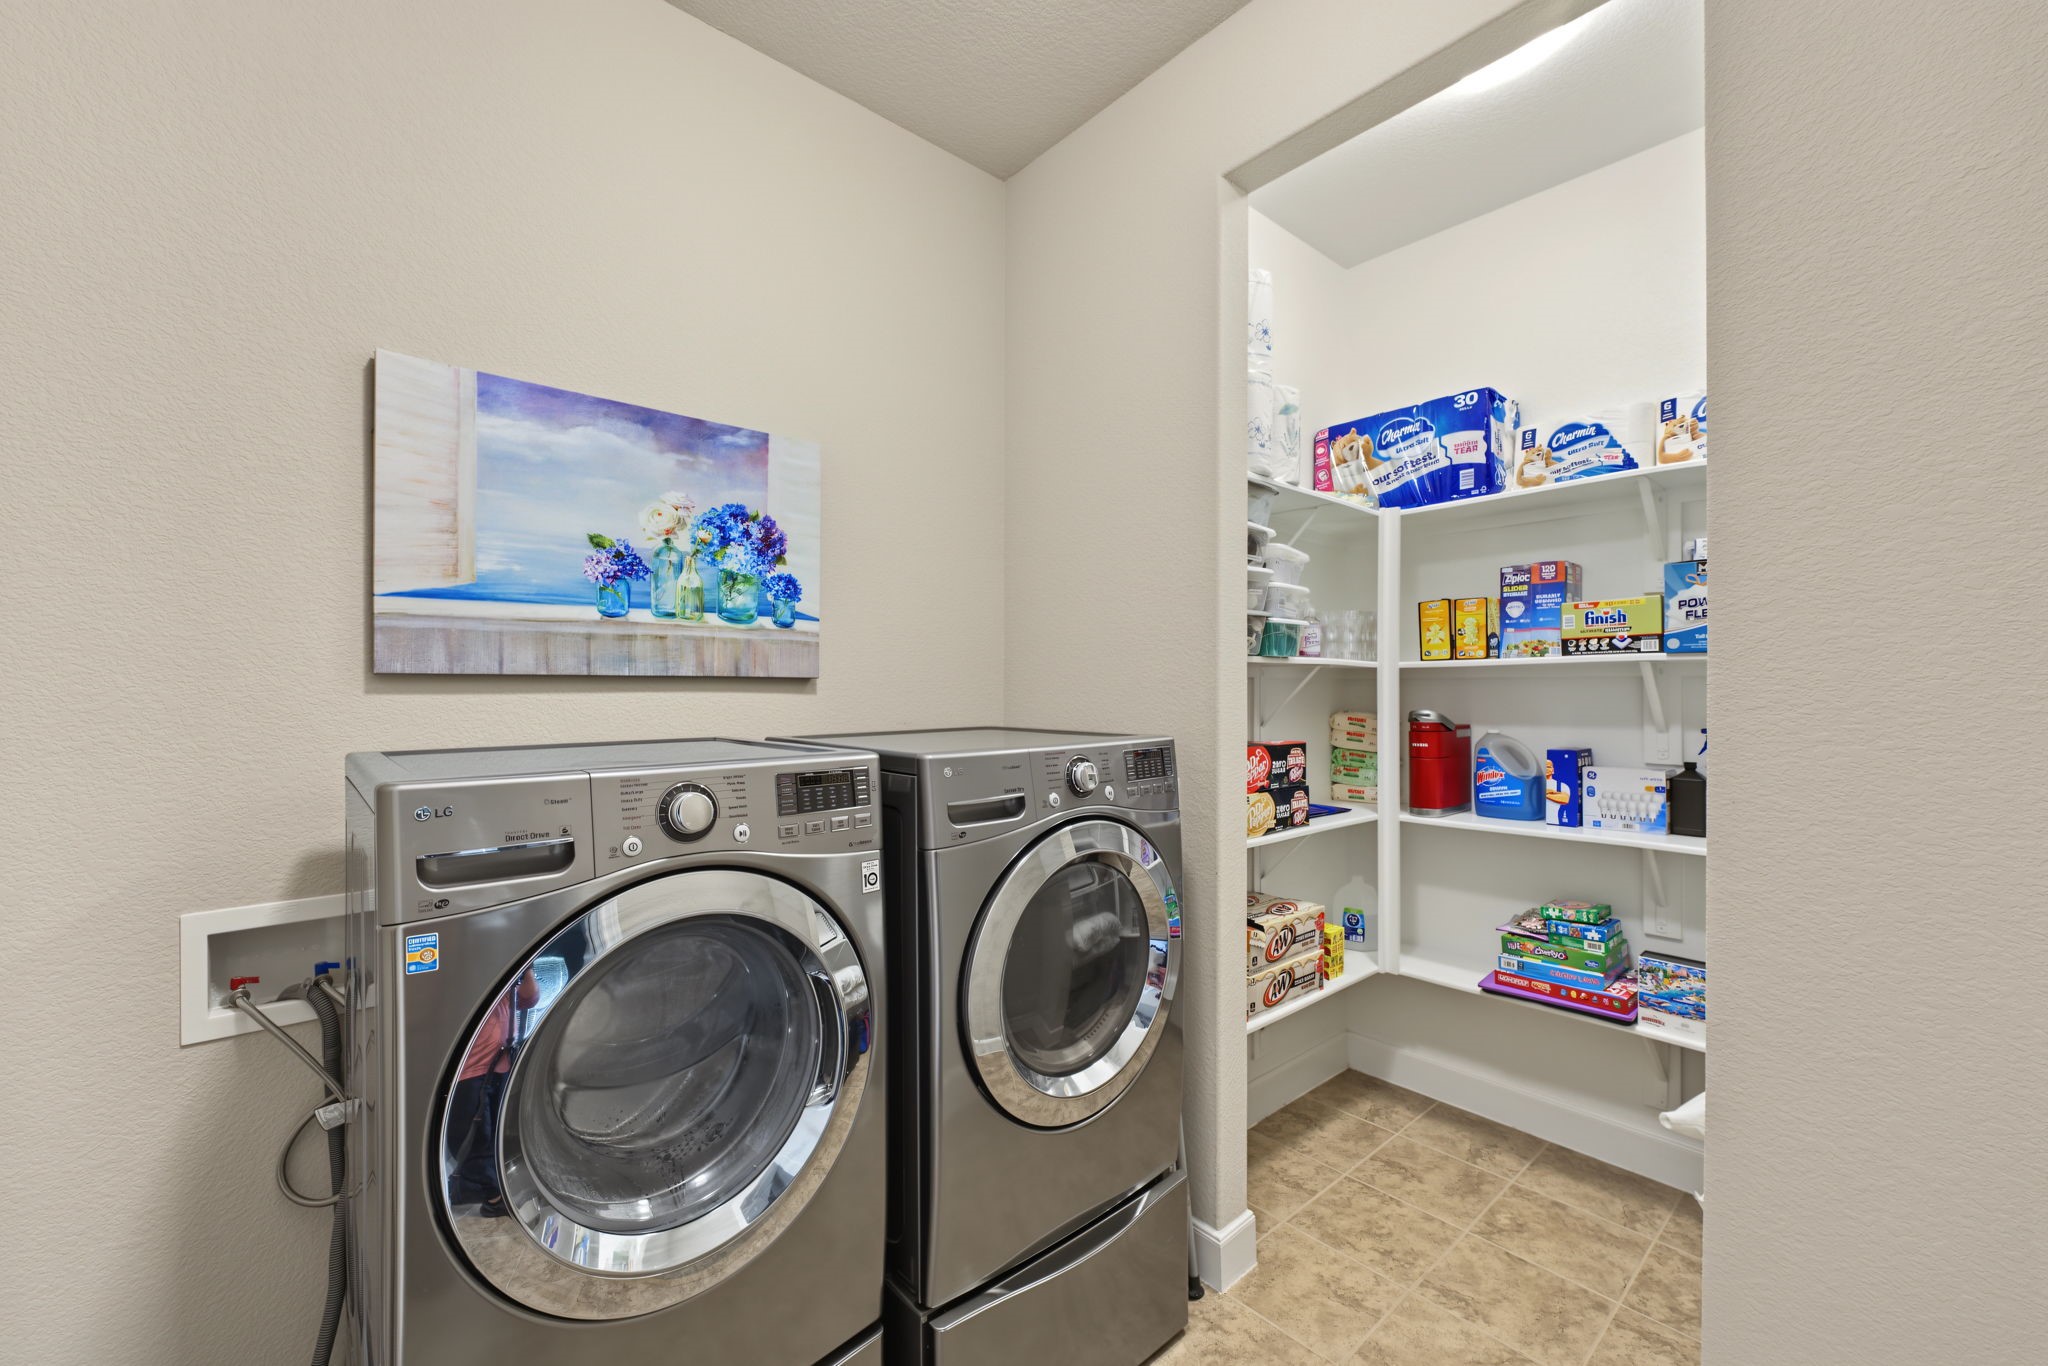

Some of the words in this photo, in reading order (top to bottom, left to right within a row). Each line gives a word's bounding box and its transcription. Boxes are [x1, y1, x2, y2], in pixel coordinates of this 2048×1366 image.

[1453, 391, 1479, 409] 30
[1663, 401, 1672, 411] 6
[1525, 431, 1533, 439] 6
[1551, 425, 1597, 448] Charmin
[1372, 472, 1392, 486] our
[1541, 564, 1556, 573] 120
[1504, 573, 1531, 585] Ziploc
[1503, 584, 1529, 593] SLIDER
[1678, 597, 1708, 610] POW
[1584, 607, 1628, 626] finish
[1685, 608, 1708, 621] FLE
[434, 806, 453, 818] LG
[505, 834, 529, 842] Direct
[530, 832, 550, 840] Drive
[863, 872, 878, 888] 10
